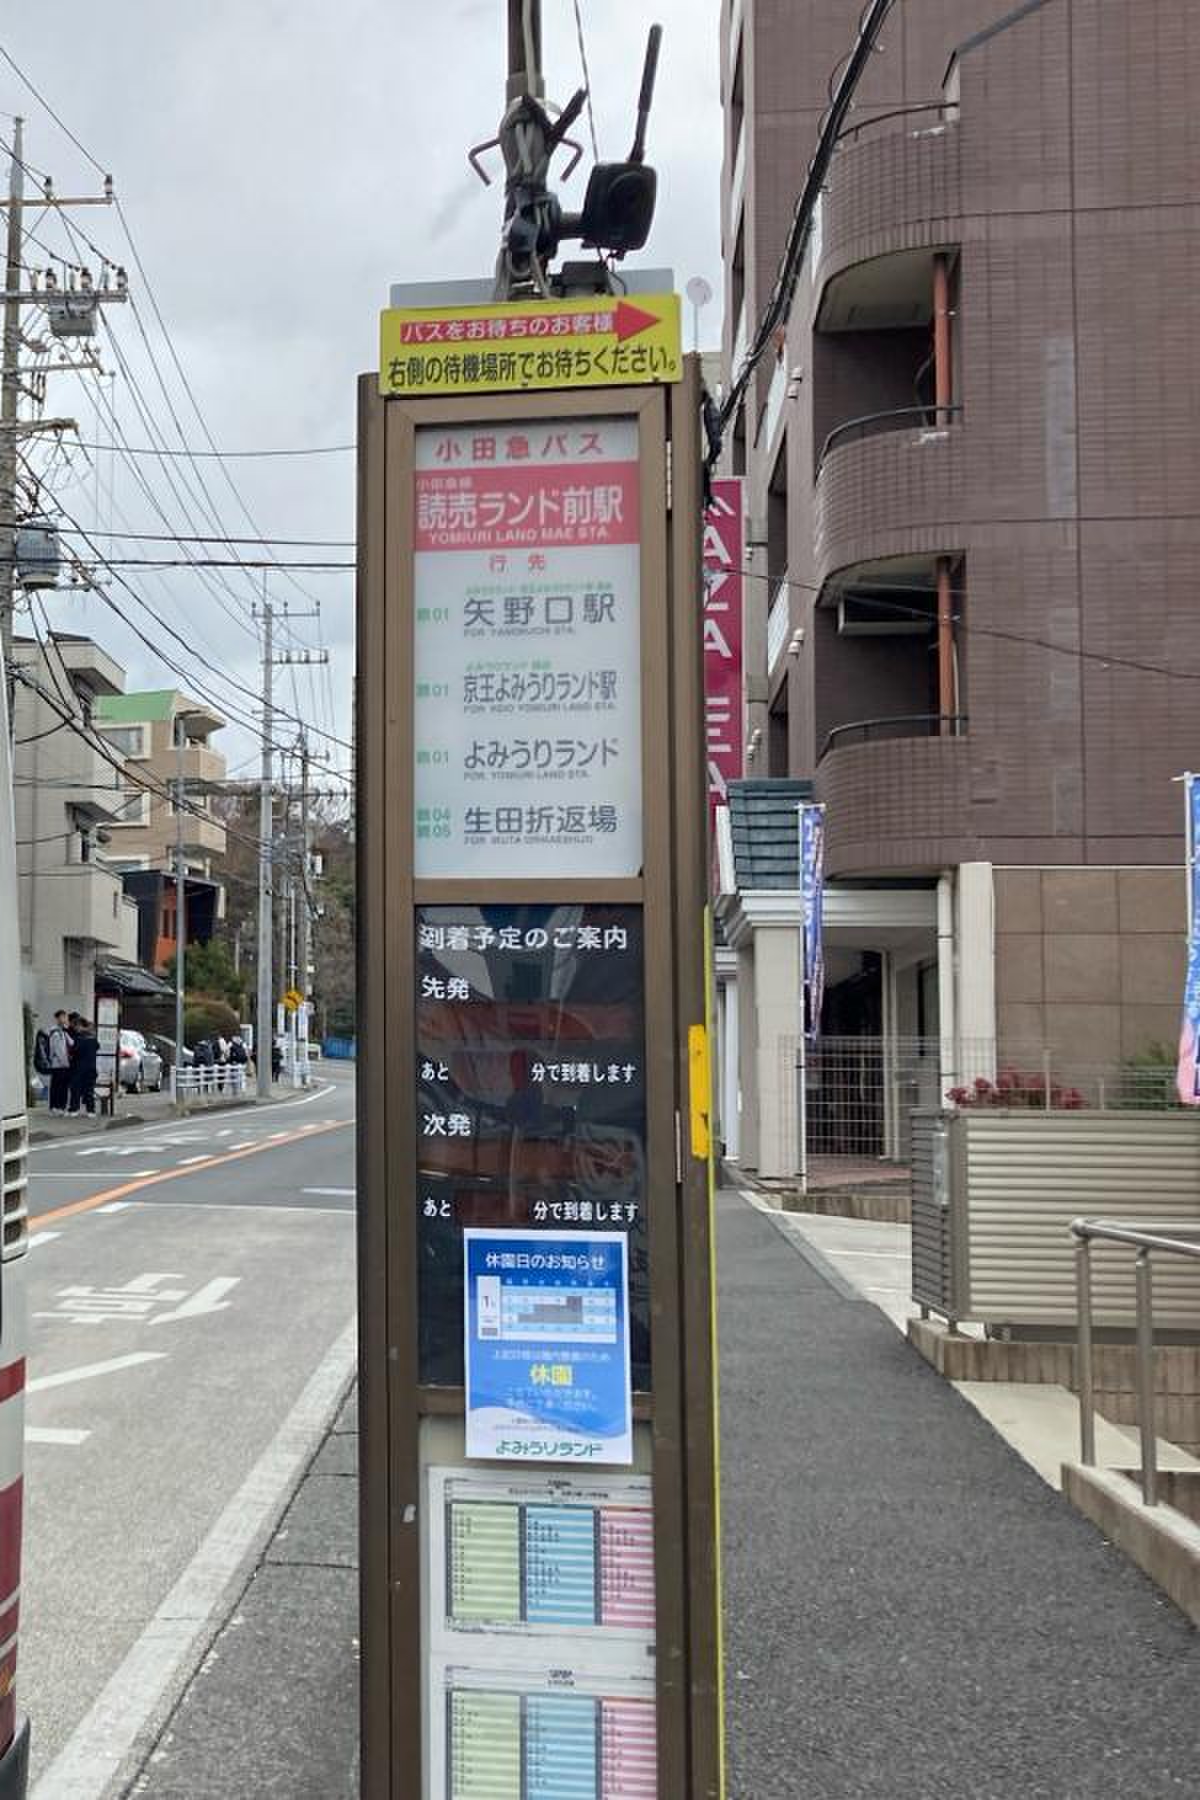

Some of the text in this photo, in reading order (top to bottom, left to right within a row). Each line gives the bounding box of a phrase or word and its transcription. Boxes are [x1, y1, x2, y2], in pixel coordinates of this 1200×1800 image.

[403, 311, 615, 342] バスをお待ちのお客様
[388, 345, 677, 387] 右側の待機場所でお待ちください。
[436, 433, 603, 462] 小田急バス
[417, 485, 623, 529] 読売ランド前駅
[431, 531, 492, 545] YOMIURI
[496, 529, 537, 543] LAND
[464, 593, 615, 626] 矢野口駅
[464, 670, 618, 703] 京王よみうりランド駅
[464, 738, 619, 768] よみうりランド
[464, 805, 617, 834] 生田折返場
[420, 925, 627, 950] 到着予定のご案内
[421, 976, 469, 999] 先発
[421, 1063, 637, 1082] あと 分で到着します
[423, 1113, 471, 1136] 次発
[423, 1200, 639, 1222] あと 分で到着します
[485, 1252, 606, 1271] 休園日のお知らせ
[530, 1363, 574, 1387] 休園
[494, 1439, 604, 1457] よみうりランド
